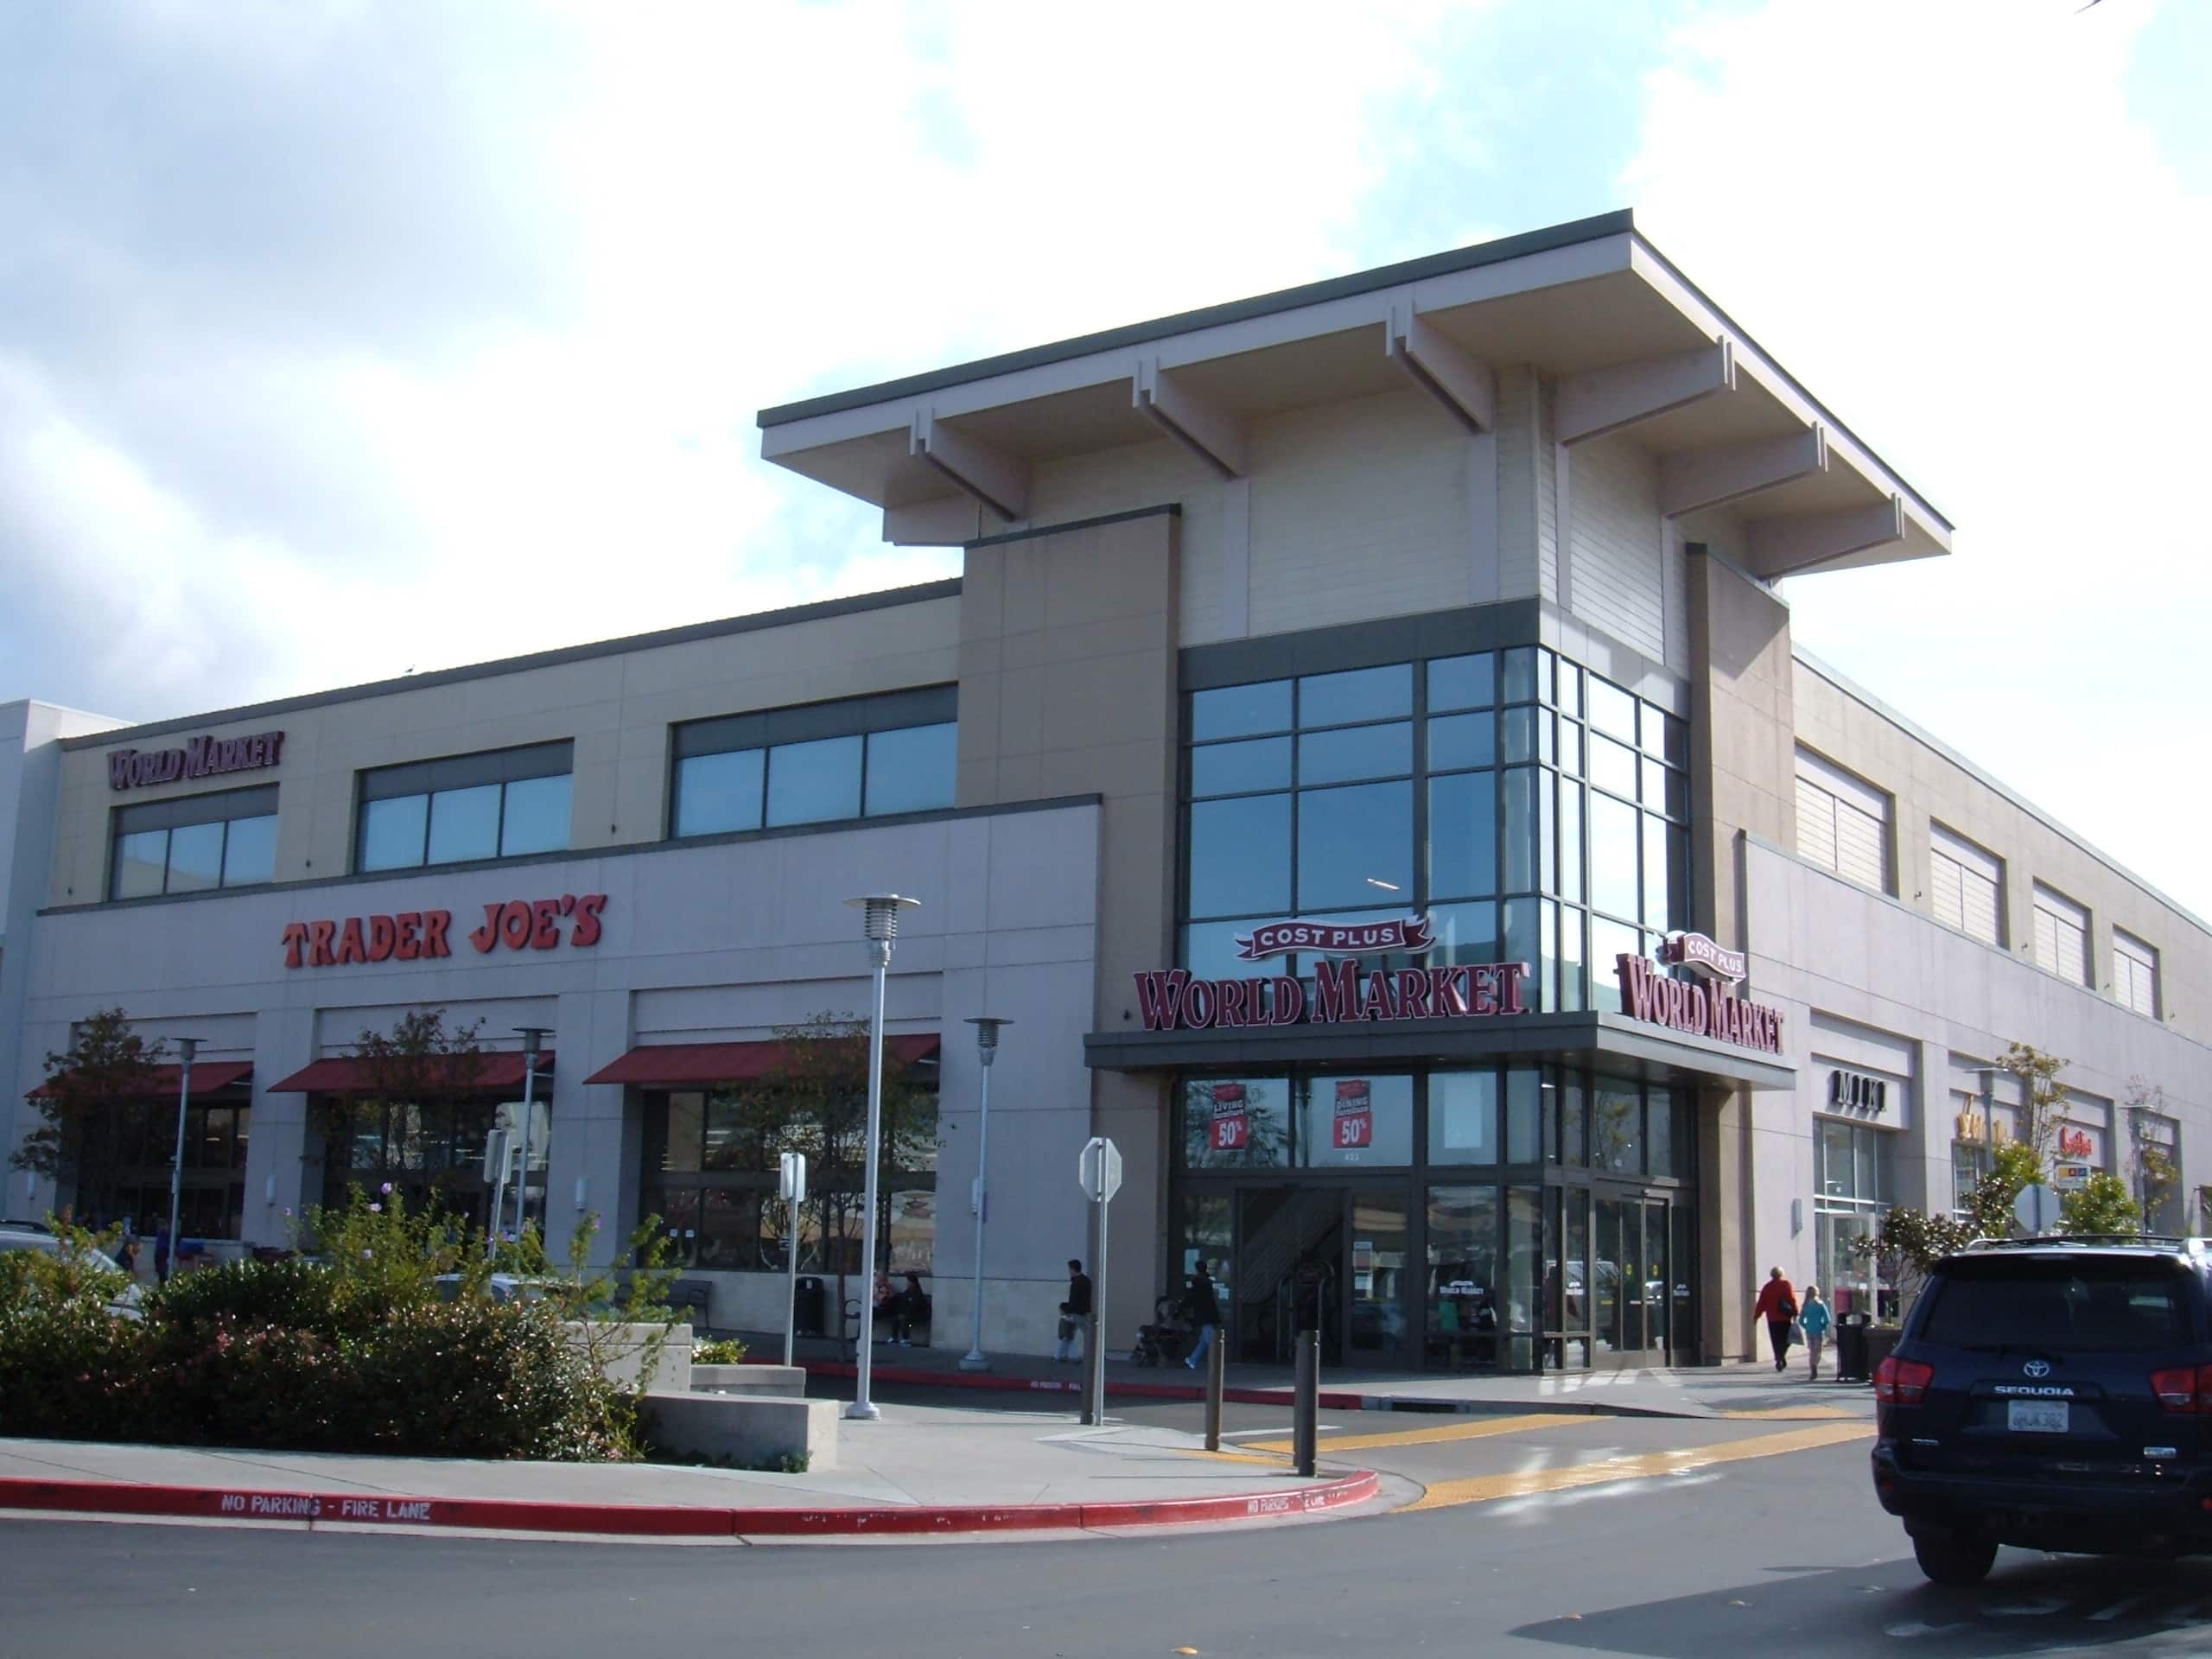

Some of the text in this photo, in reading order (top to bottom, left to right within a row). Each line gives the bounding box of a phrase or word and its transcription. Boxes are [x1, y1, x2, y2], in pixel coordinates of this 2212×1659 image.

[108, 731, 285, 790] WORLD MARKET
[282, 893, 607, 969] TRADER JOE'S
[1261, 927, 1395, 947] COST PLUS
[1688, 940, 1743, 973] COST PLUS
[1134, 958, 1532, 1030] WORLD MARKET
[1619, 954, 1784, 1055] WORLD MARKET
[1831, 1070, 1888, 1112] MIKI
[1994, 1385, 2075, 1396] SEQUOIA
[222, 1494, 245, 1511] NO
[251, 1496, 321, 1515] PARKING
[341, 1500, 379, 1517] FIRE
[386, 1502, 430, 1521] LANE
